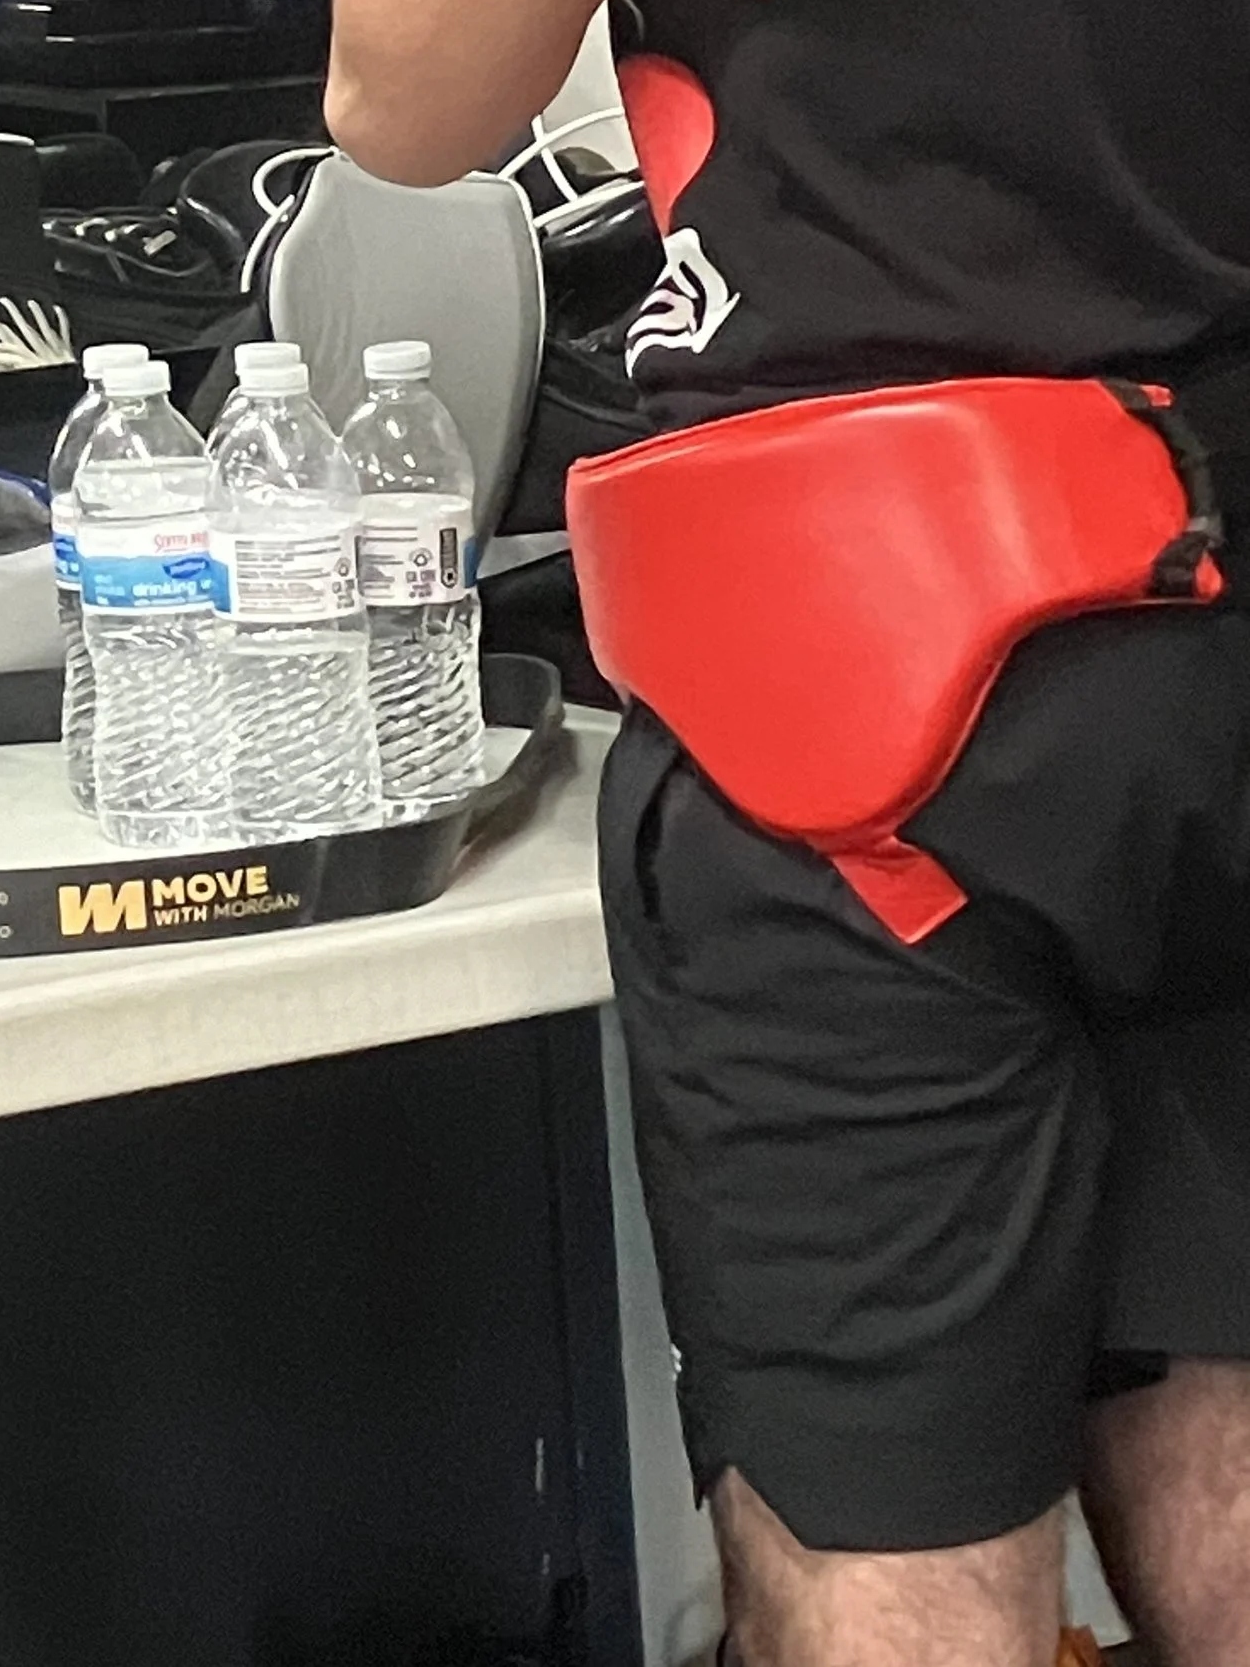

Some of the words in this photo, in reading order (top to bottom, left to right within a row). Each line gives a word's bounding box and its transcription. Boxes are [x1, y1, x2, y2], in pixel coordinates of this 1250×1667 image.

[133, 580, 197, 597] drinking
[151, 866, 269, 907] MOVE
[153, 906, 208, 927] WITH
[213, 893, 300, 921] MORGAN
